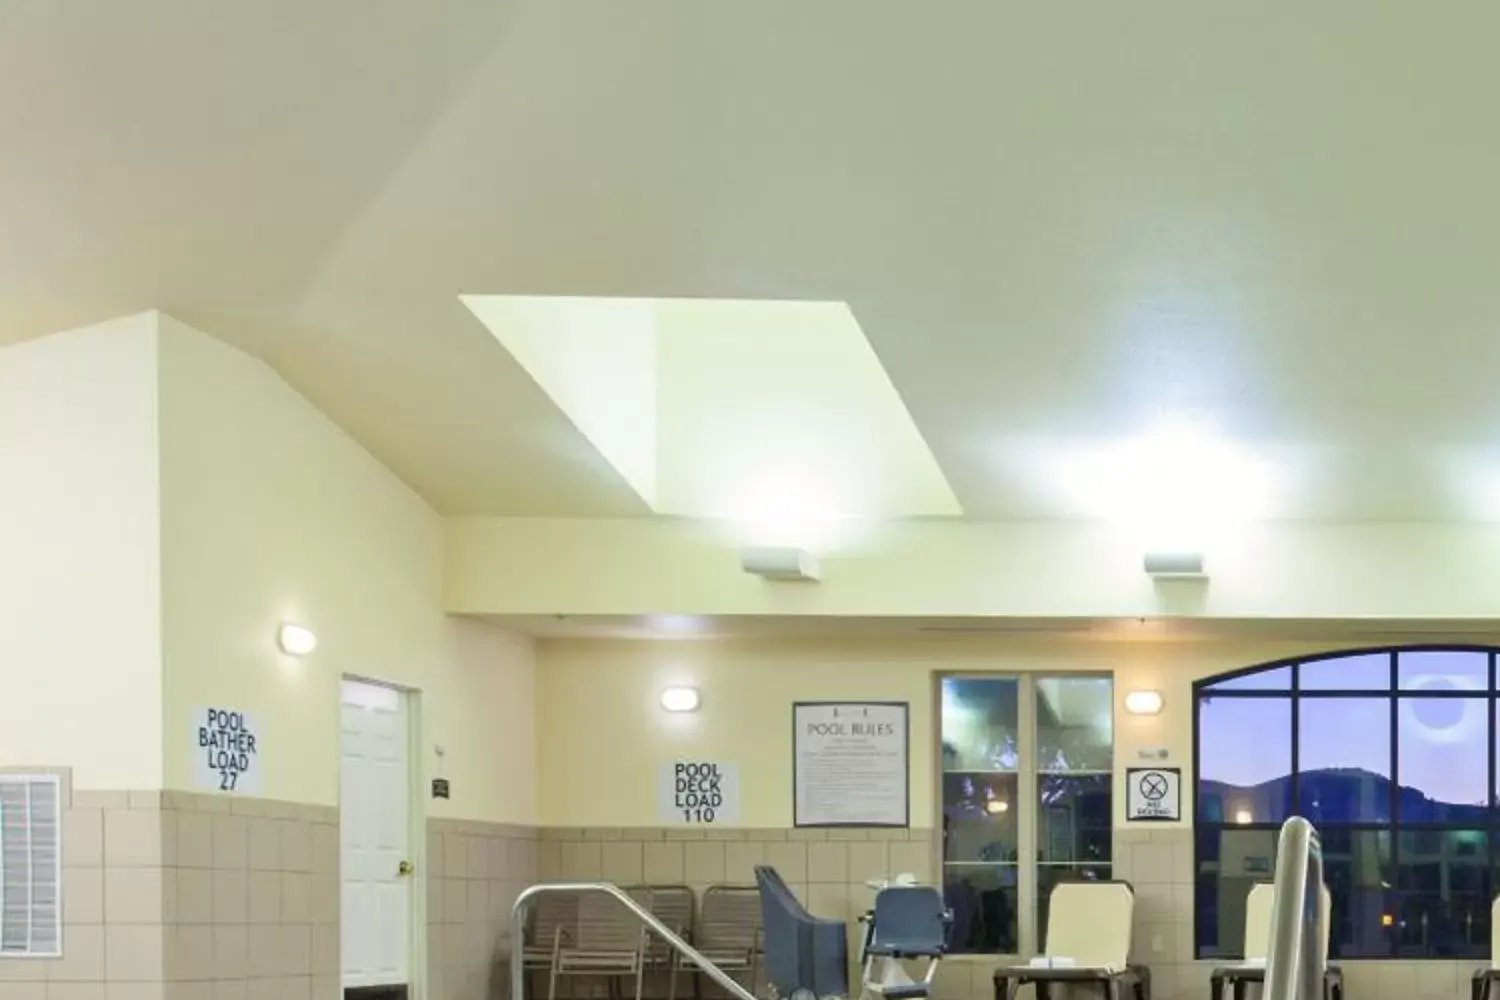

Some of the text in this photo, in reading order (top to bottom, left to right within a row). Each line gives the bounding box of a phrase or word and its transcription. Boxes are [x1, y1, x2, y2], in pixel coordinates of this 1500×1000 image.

[208, 708, 249, 733] POOL
[807, 723, 894, 737] POOL RULES
[199, 727, 257, 754] BATHER
[208, 748, 249, 772] LOAD
[675, 763, 720, 779] POOL
[219, 770, 237, 791] 27
[675, 777, 722, 793] DECK
[675, 793, 723, 808] LOAD
[682, 808, 715, 823] 110
